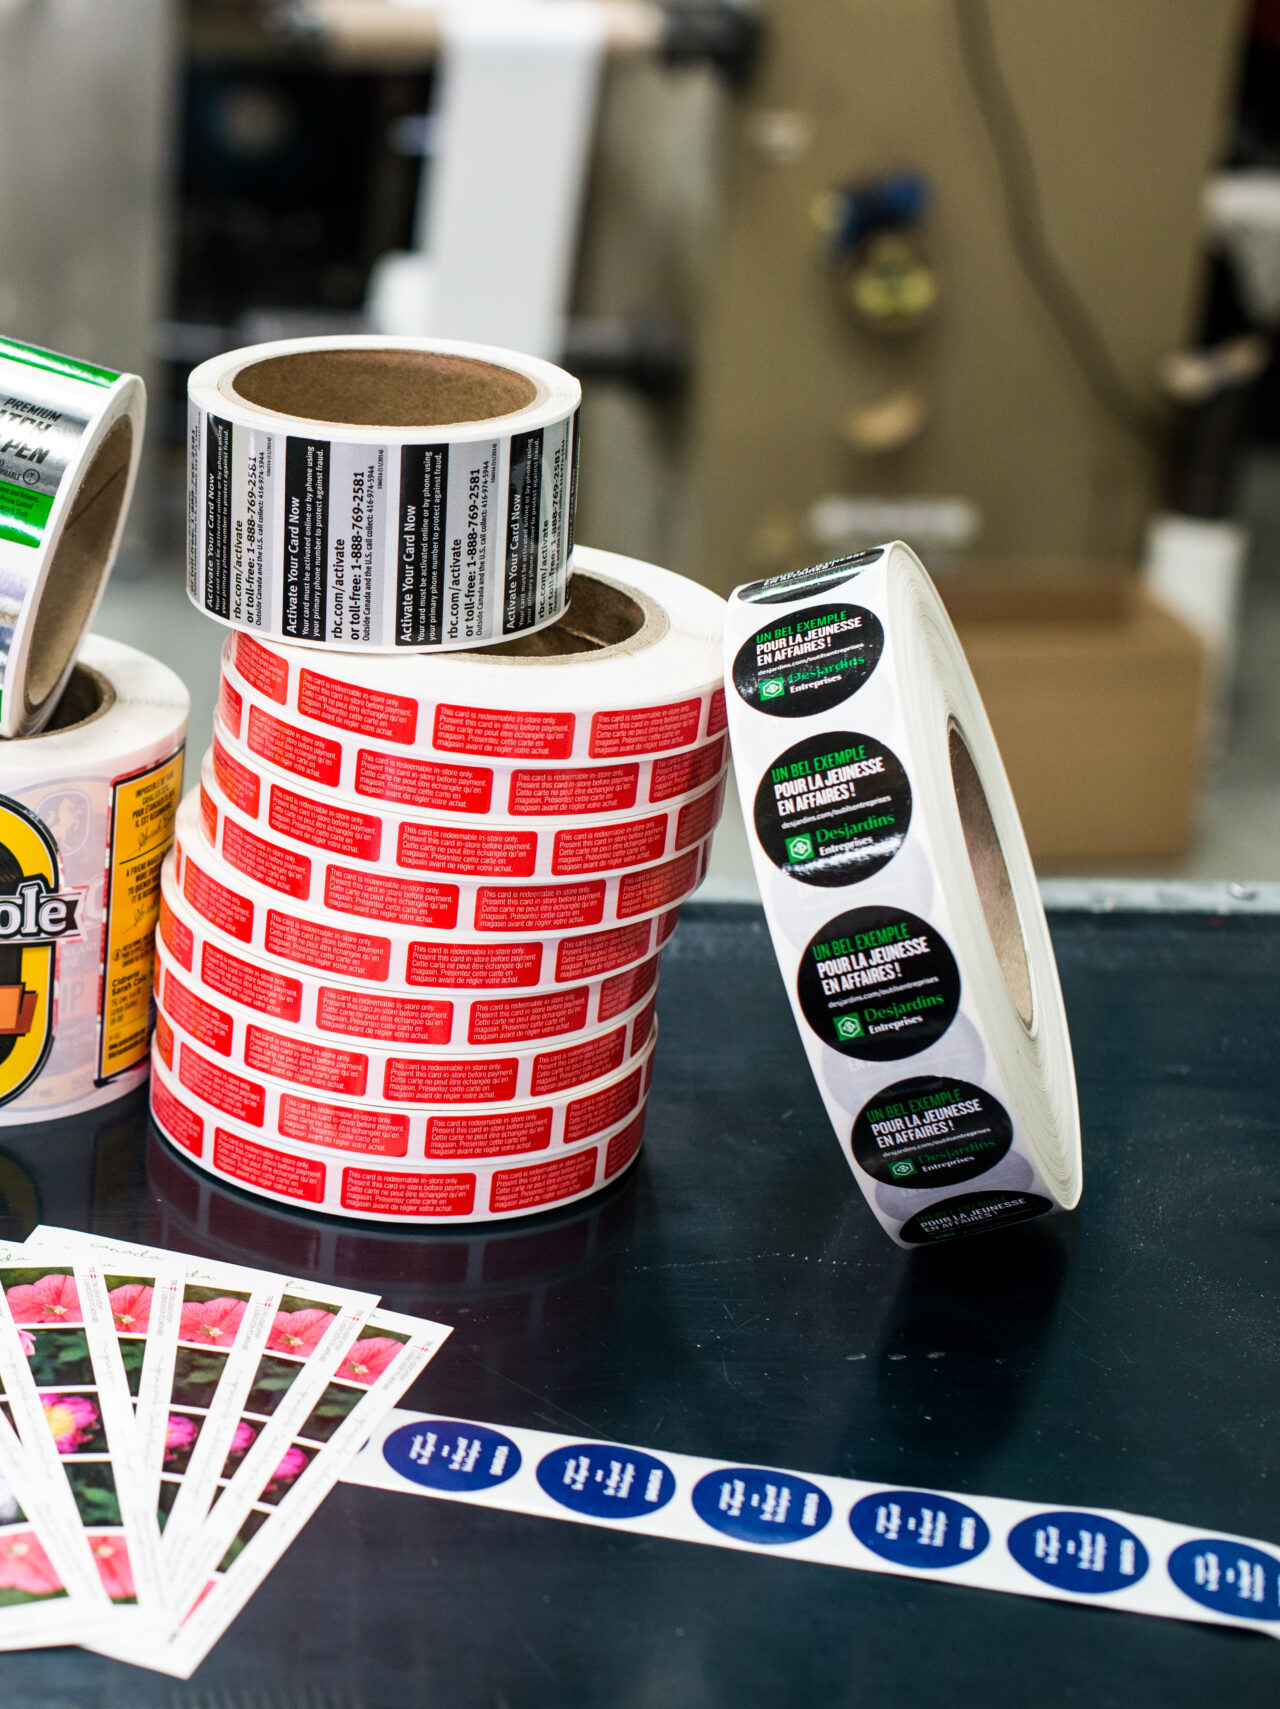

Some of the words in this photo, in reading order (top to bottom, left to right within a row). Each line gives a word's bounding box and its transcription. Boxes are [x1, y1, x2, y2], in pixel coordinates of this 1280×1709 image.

[4, 397, 63, 423] PREMIUM
[305, 445, 314, 466] using
[315, 449, 323, 470] fraud.
[305, 467, 313, 491] phone
[315, 472, 324, 499] against
[366, 465, 374, 513] 416-974-5944
[288, 496, 299, 523] Now
[304, 492, 313, 502] by
[306, 503, 311, 511] or
[315, 500, 323, 527] protect
[350, 471, 364, 570] 1-888-769-2581
[365, 514, 373, 537] collect:
[288, 525, 299, 553] Card
[314, 528, 321, 536] to
[364, 538, 372, 550] call
[303, 536, 311, 570] activated
[313, 537, 321, 565] number
[364, 551, 372, 564] U.S.
[287, 555, 298, 582] Your
[302, 571, 310, 581] be
[313, 566, 321, 590] phone
[330, 538, 345, 638] rbc.com/activate
[363, 577, 371, 590] and
[286, 584, 297, 633] Activate
[312, 590, 321, 619] primary
[348, 574, 361, 624] toll-free:
[362, 591, 371, 615] Canada
[301, 618, 309, 635] Your
[350, 627, 359, 640] or
[362, 615, 370, 641] Outside
[771, 766, 788, 782] UN
[790, 760, 812, 777] BEL
[813, 744, 866, 771] EXEMPLE
[773, 777, 808, 799] POUR
[806, 773, 824, 790] LA
[824, 756, 885, 786] JEUNESSE
[776, 798, 795, 816] EN
[795, 783, 850, 811] AFFAIRES
[848, 781, 856, 796] !
[402, 832, 426, 842] Present
[427, 836, 439, 844] this
[456, 840, 480, 848] in-store
[481, 841, 502, 849] before
[503, 840, 531, 850] payment.
[403, 824, 416, 834] This
[417, 828, 432, 836] card
[440, 831, 477, 840] redeemable
[503, 835, 517, 843] only.
[815, 814, 895, 843] Desjardins
[818, 836, 875, 856] Entreprises
[812, 943, 830, 960] UN
[831, 937, 854, 955] BEL
[854, 922, 909, 949] EXEMPLE
[816, 956, 852, 978] POUR
[849, 952, 868, 969] LA
[868, 936, 930, 965] JEUNESSE
[821, 977, 840, 995] EN
[840, 963, 895, 990] AFFAIRES
[893, 961, 902, 976] !
[863, 994, 944, 1026] Desjardins
[867, 1015, 923, 1034] Entreprises
